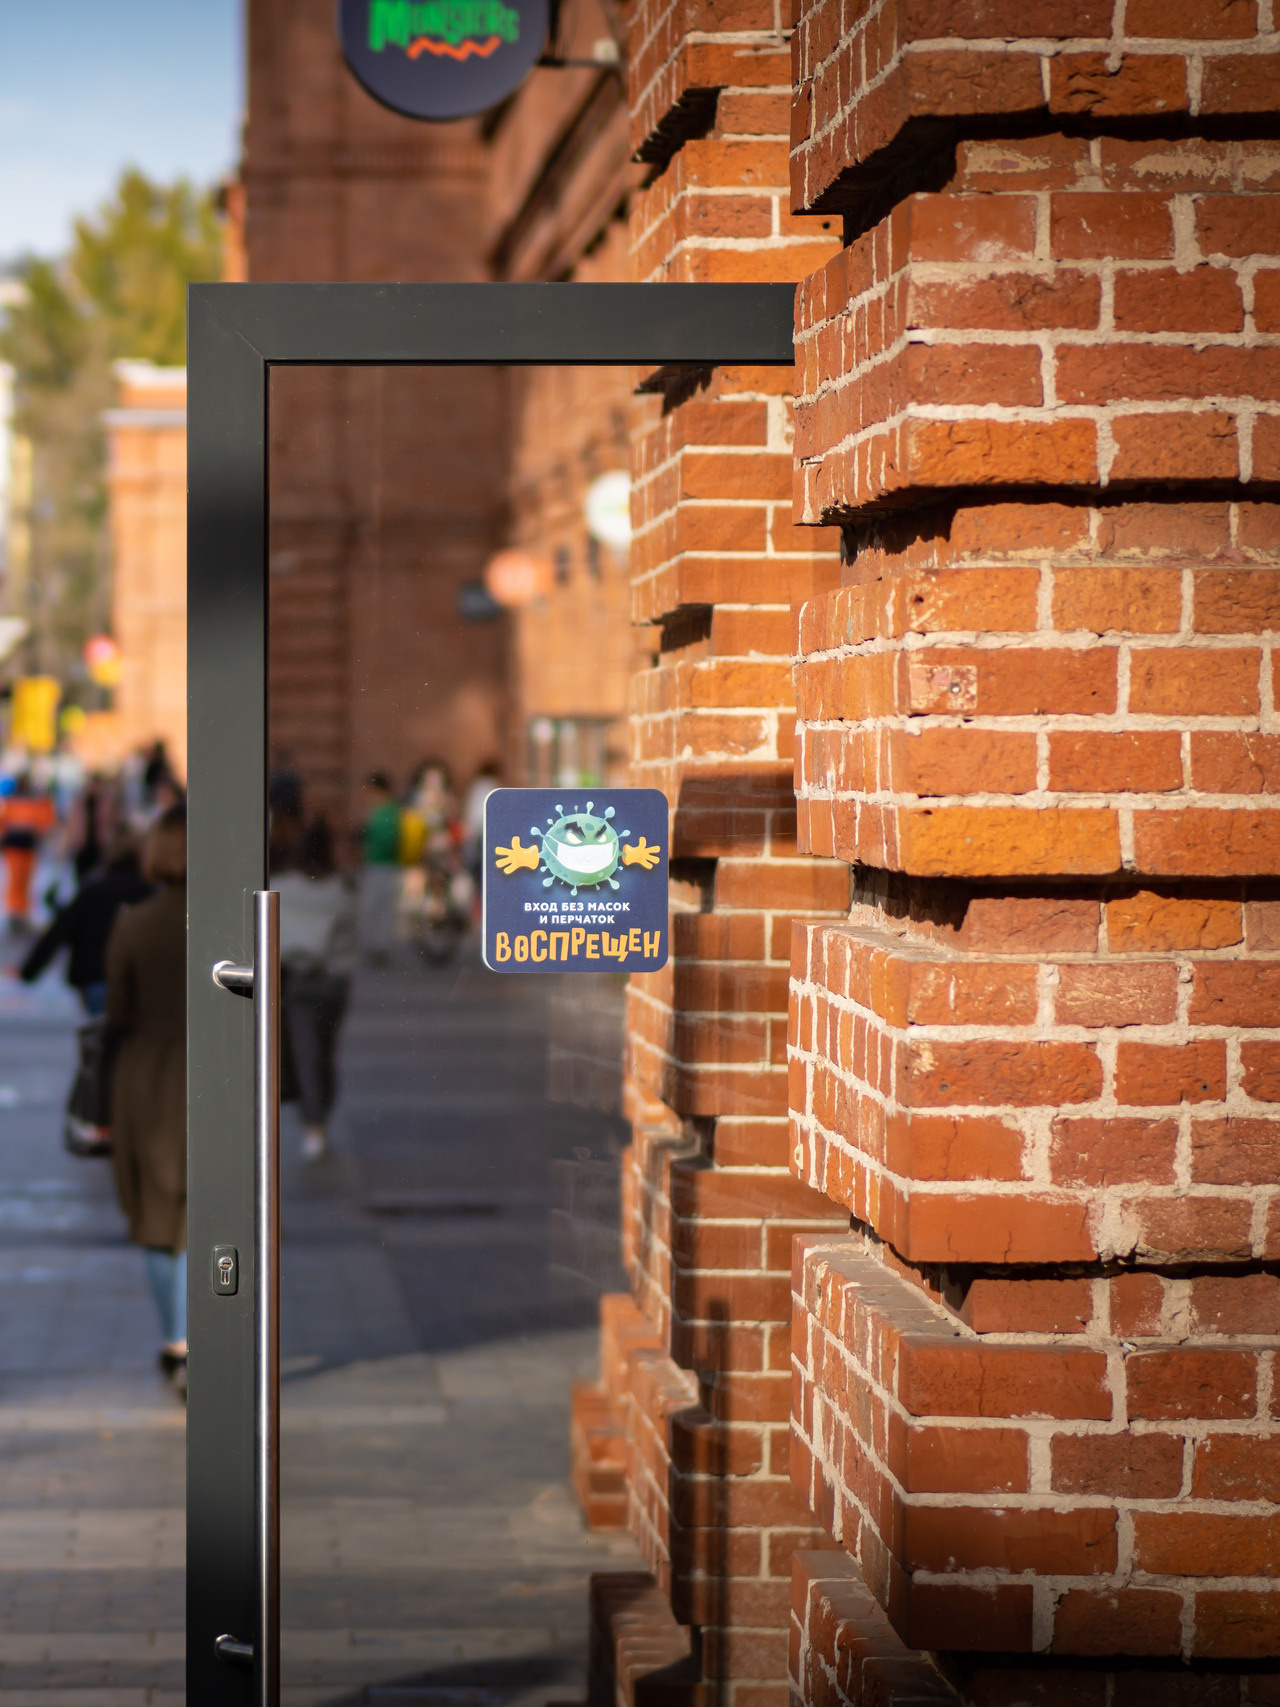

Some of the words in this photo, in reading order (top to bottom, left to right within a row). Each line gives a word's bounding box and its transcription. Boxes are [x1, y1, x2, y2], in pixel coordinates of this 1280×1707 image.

[524, 902, 558, 912] ВХОД
[561, 902, 584, 911] БЕЗ
[587, 902, 630, 911] МАСОК
[539, 915, 548, 924] И
[552, 915, 615, 924] ПЕРЧАТОК
[495, 927, 661, 962] ВОСПРЕЩЕН
